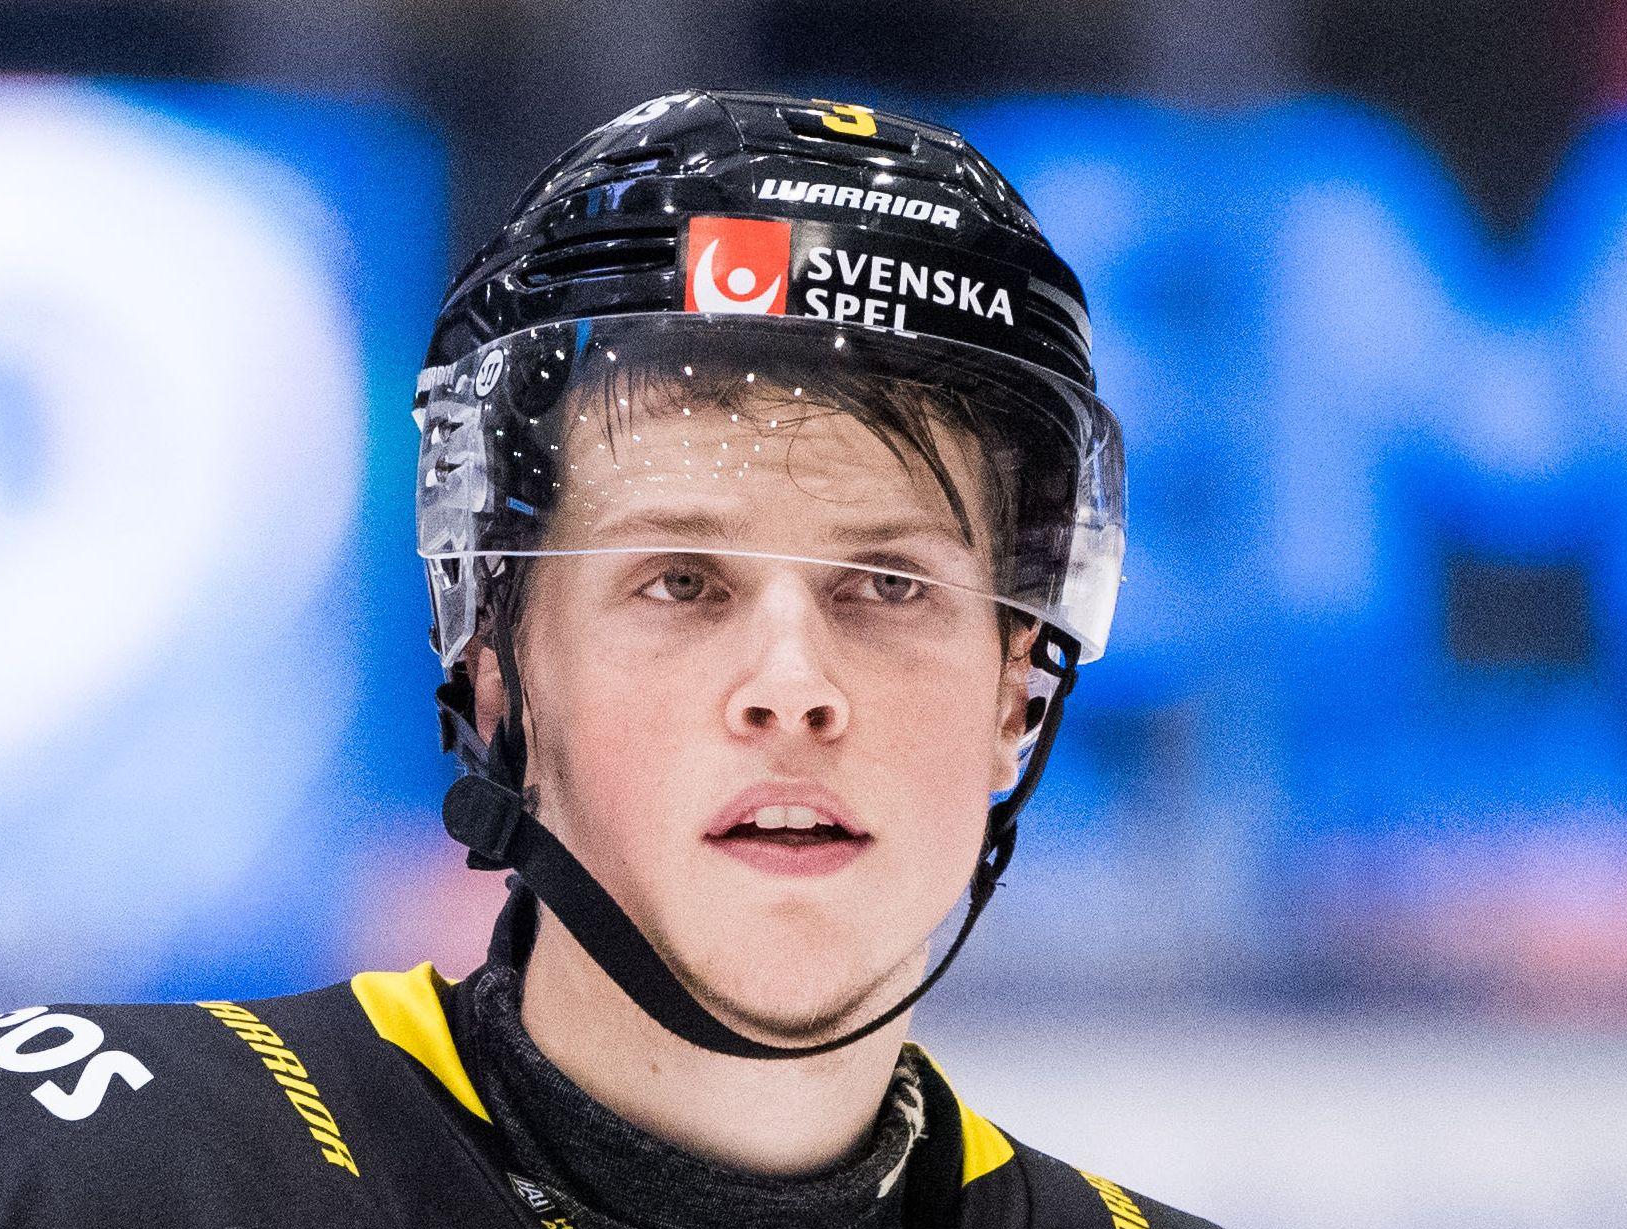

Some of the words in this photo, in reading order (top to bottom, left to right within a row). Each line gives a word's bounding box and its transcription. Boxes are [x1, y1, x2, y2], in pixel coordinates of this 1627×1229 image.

[758, 178, 961, 230] WARRIOR
[806, 246, 1015, 327] SVENSKA
[804, 287, 919, 340] SPEL
